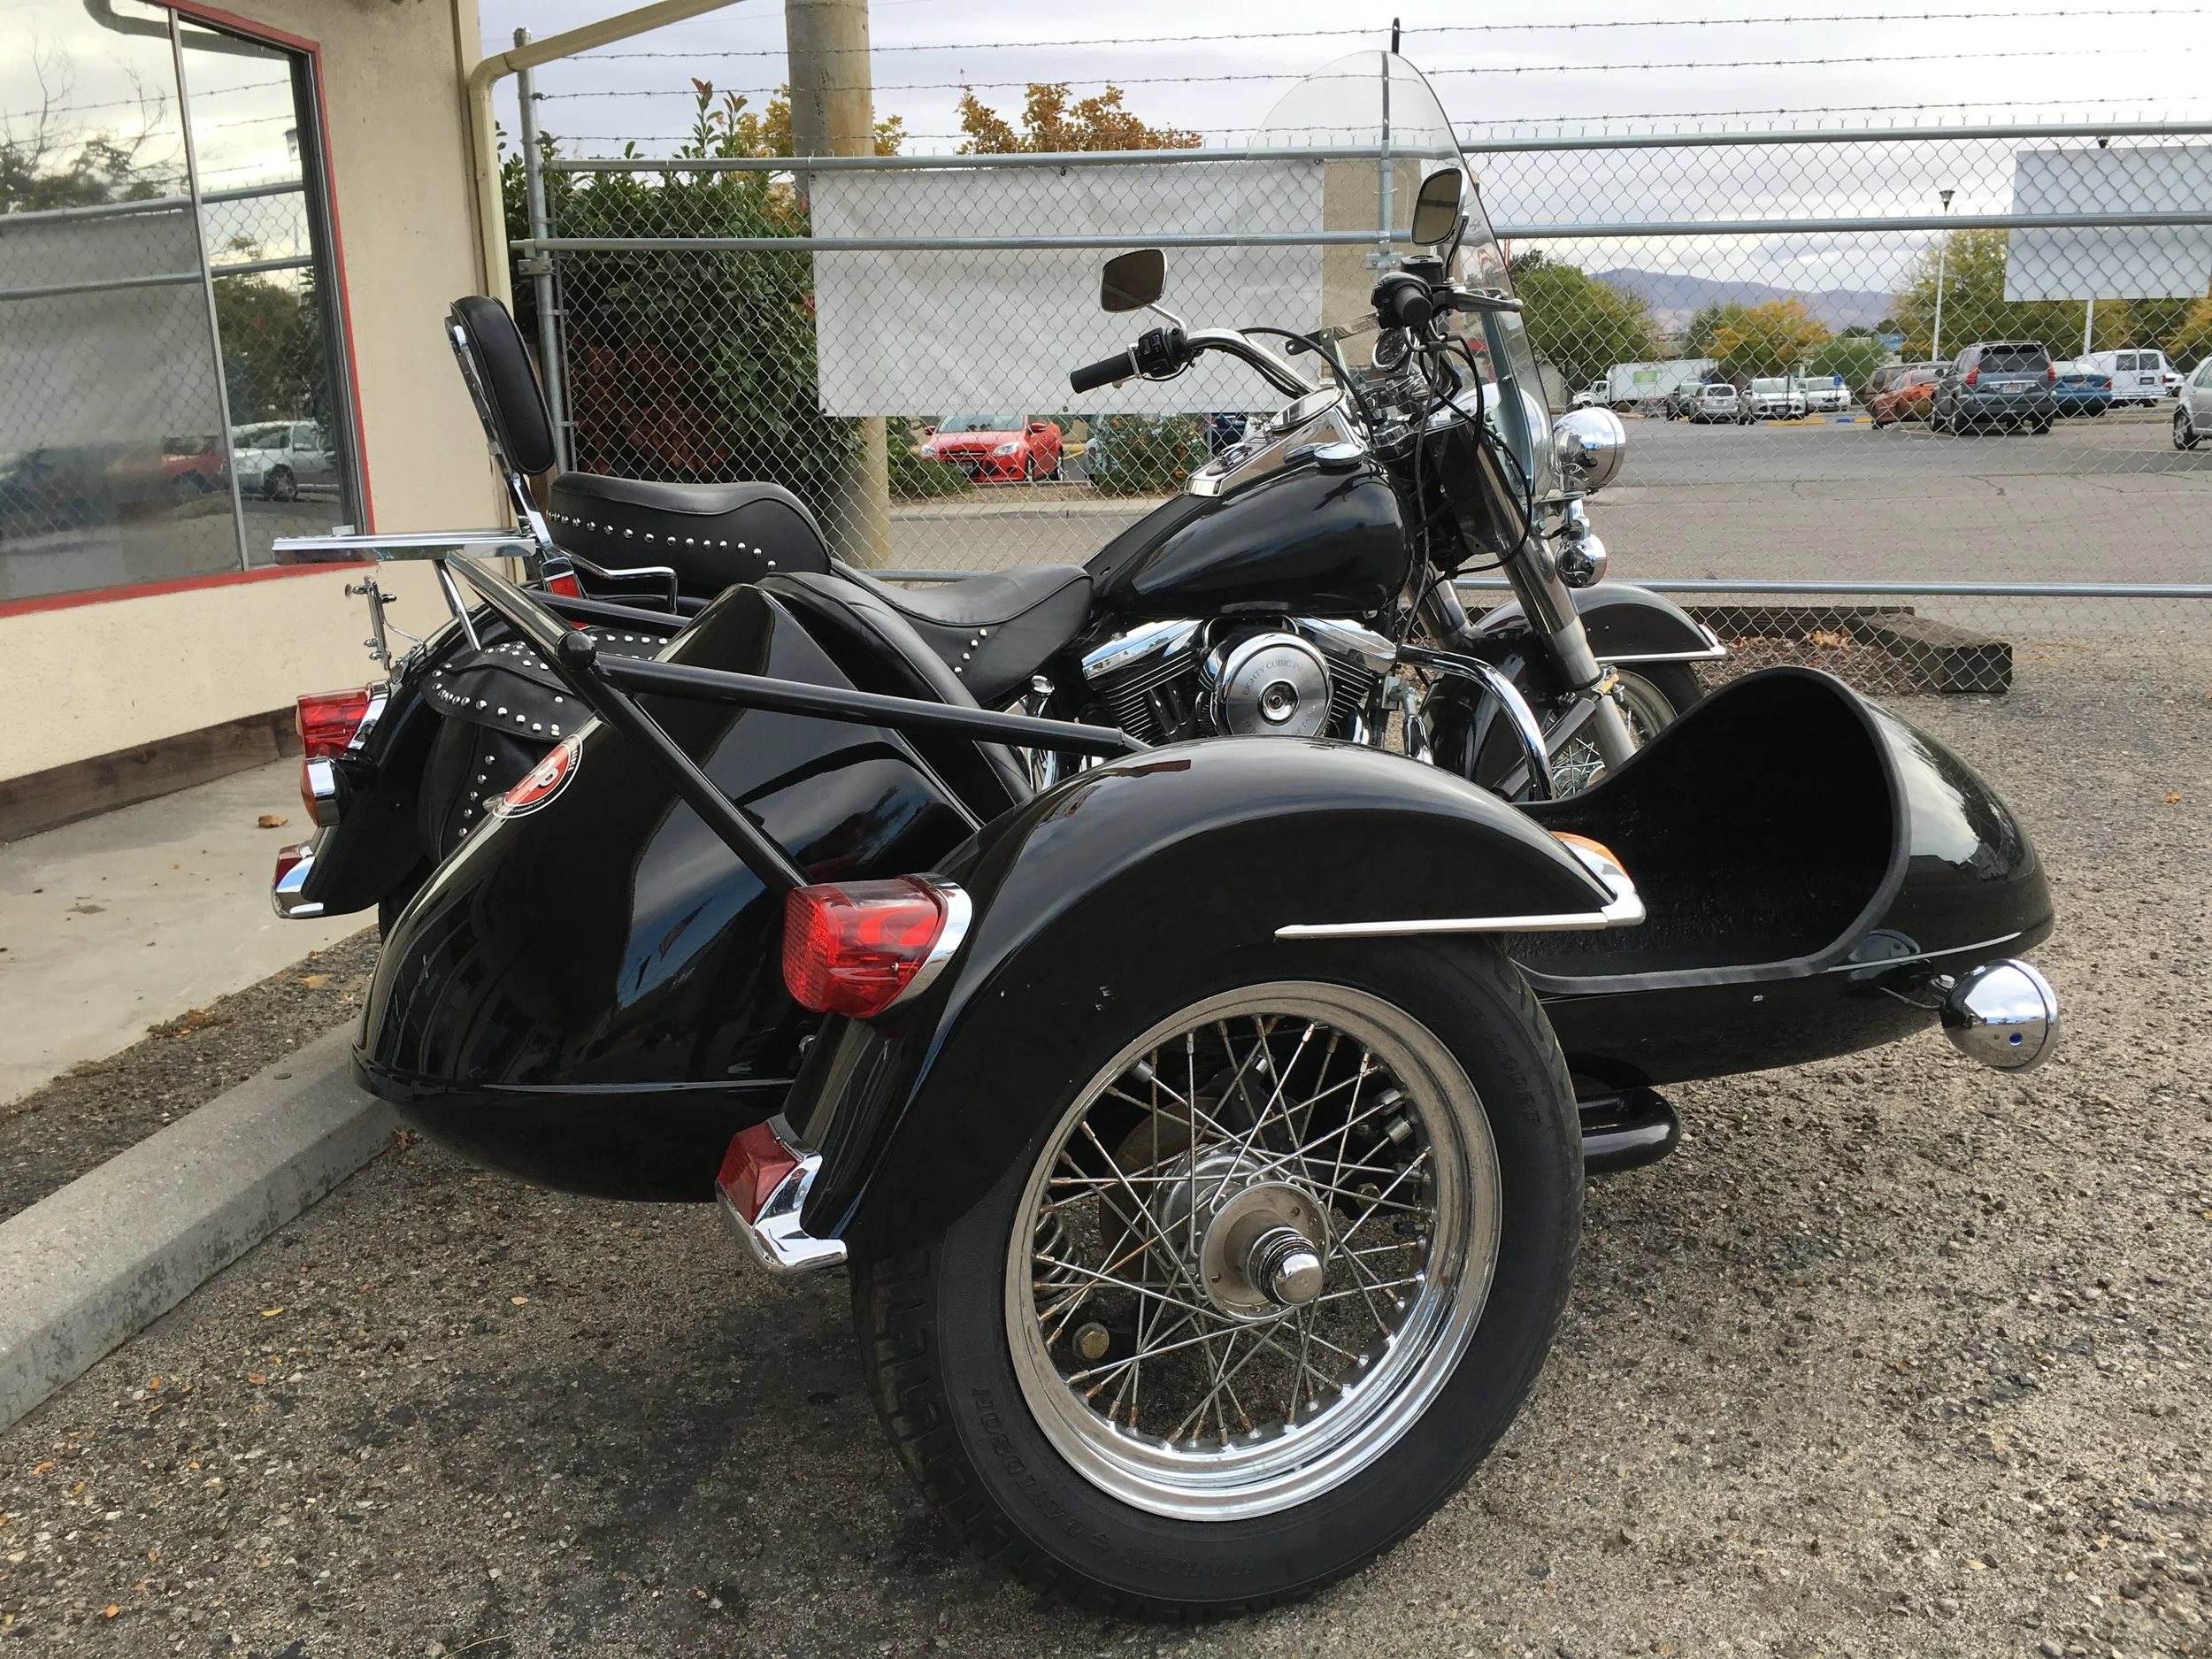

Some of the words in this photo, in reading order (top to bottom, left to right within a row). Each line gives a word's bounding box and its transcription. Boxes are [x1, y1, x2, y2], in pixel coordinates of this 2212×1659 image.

[1242, 666, 1265, 696] EIGHTY
[1265, 659, 1293, 670] CUBIC
[971, 1386, 1088, 1538] DAVIDSON
